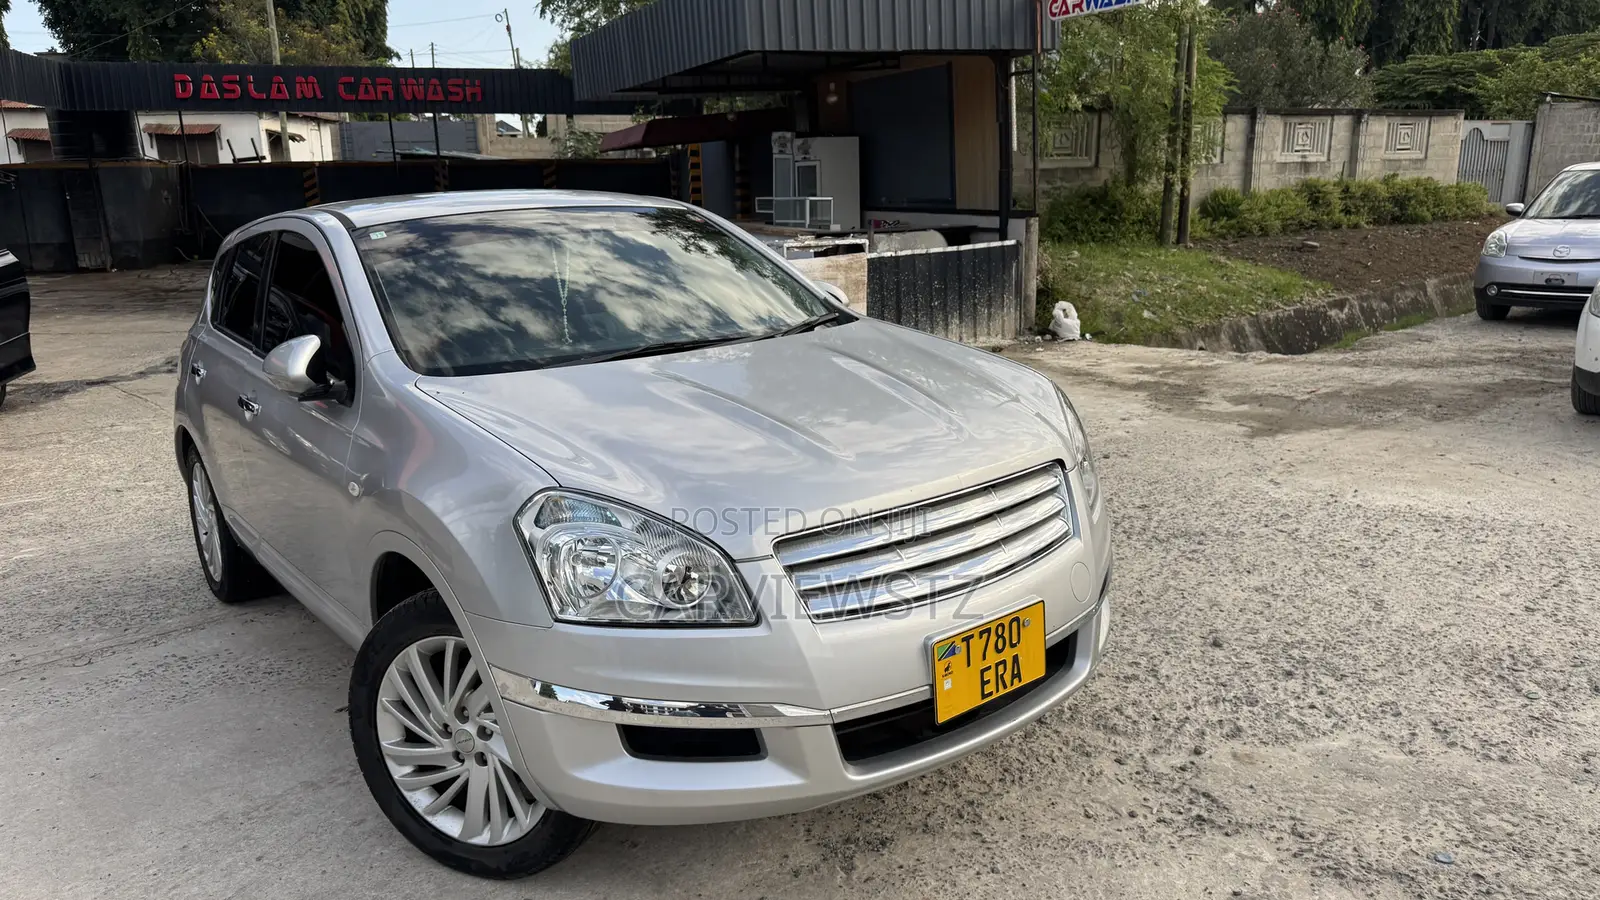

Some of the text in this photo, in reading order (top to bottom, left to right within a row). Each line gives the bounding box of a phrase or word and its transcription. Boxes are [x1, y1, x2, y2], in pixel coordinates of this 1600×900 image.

[173, 73, 483, 102] DASLAM CAR WASH
[961, 615, 1021, 668] T780
[979, 653, 1022, 701] ERA
